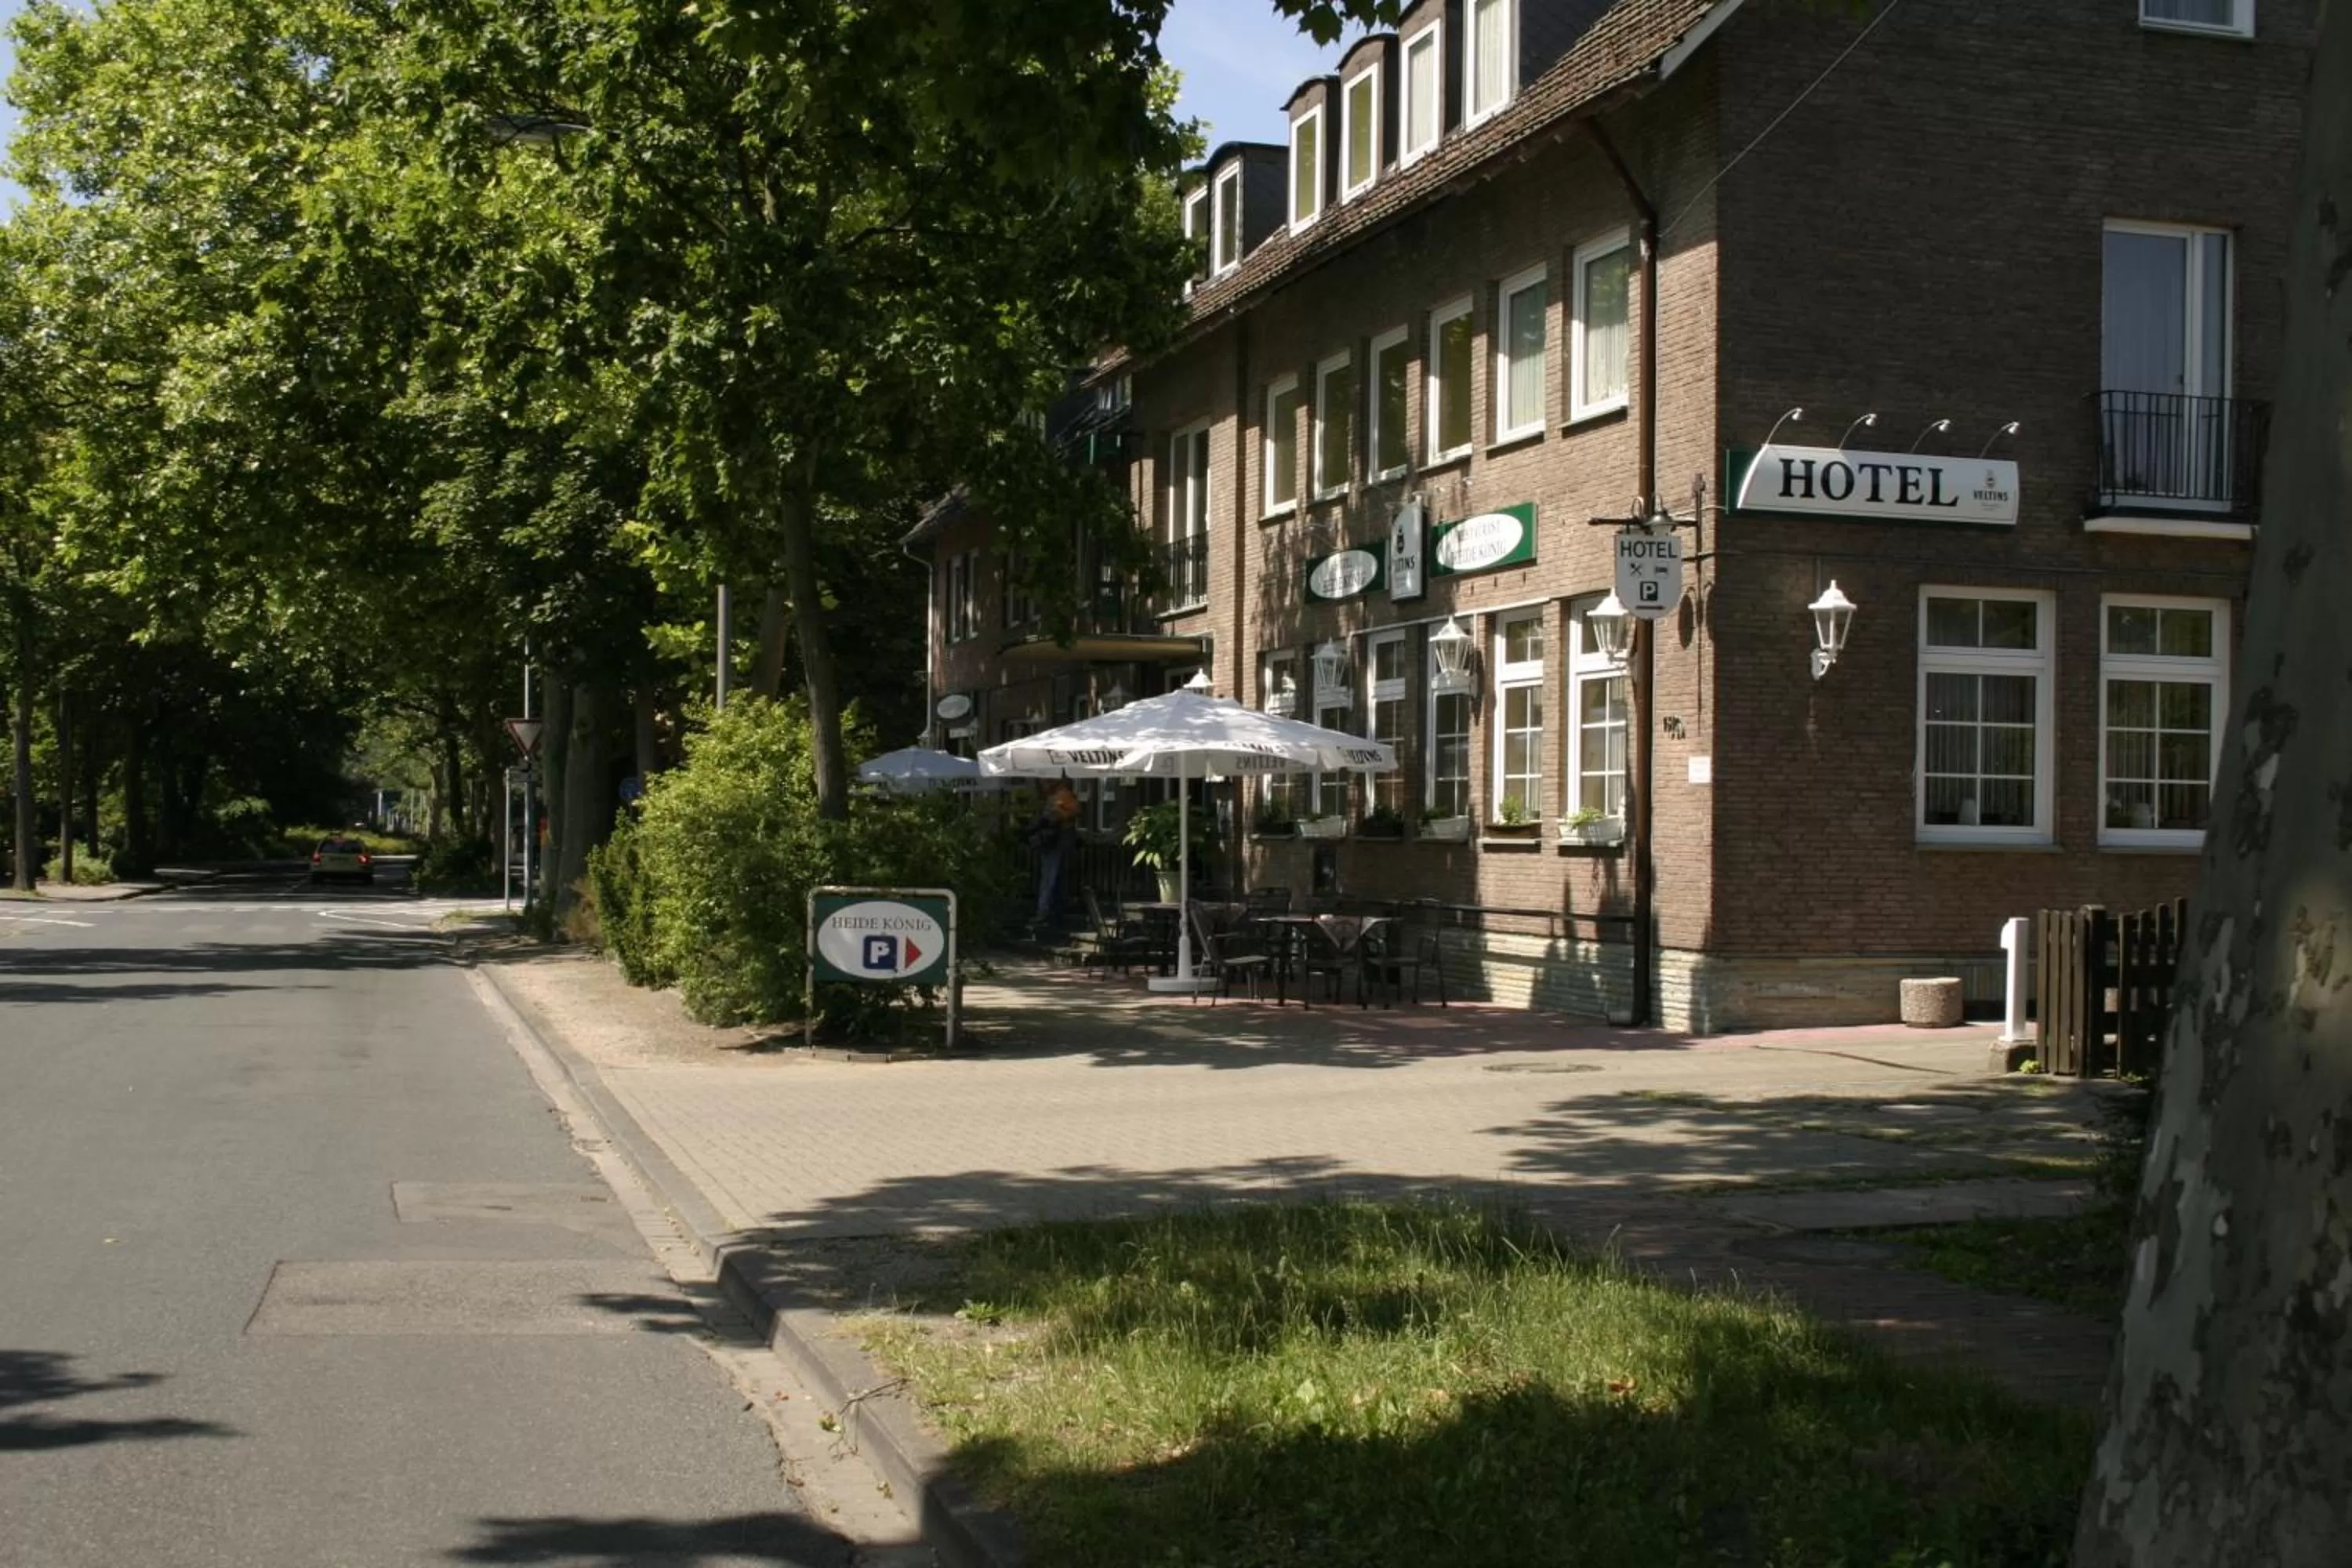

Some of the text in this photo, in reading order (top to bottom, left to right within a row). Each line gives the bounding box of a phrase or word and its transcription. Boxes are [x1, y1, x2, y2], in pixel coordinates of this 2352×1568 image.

[1778, 458, 1959, 507] HOTEL
[1973, 490, 2009, 503] VELTINS
[1620, 540, 1679, 559] HOTEL
[1067, 749, 1124, 765] VELTINS
[831, 916, 931, 931] HEIDE KÖNIG
